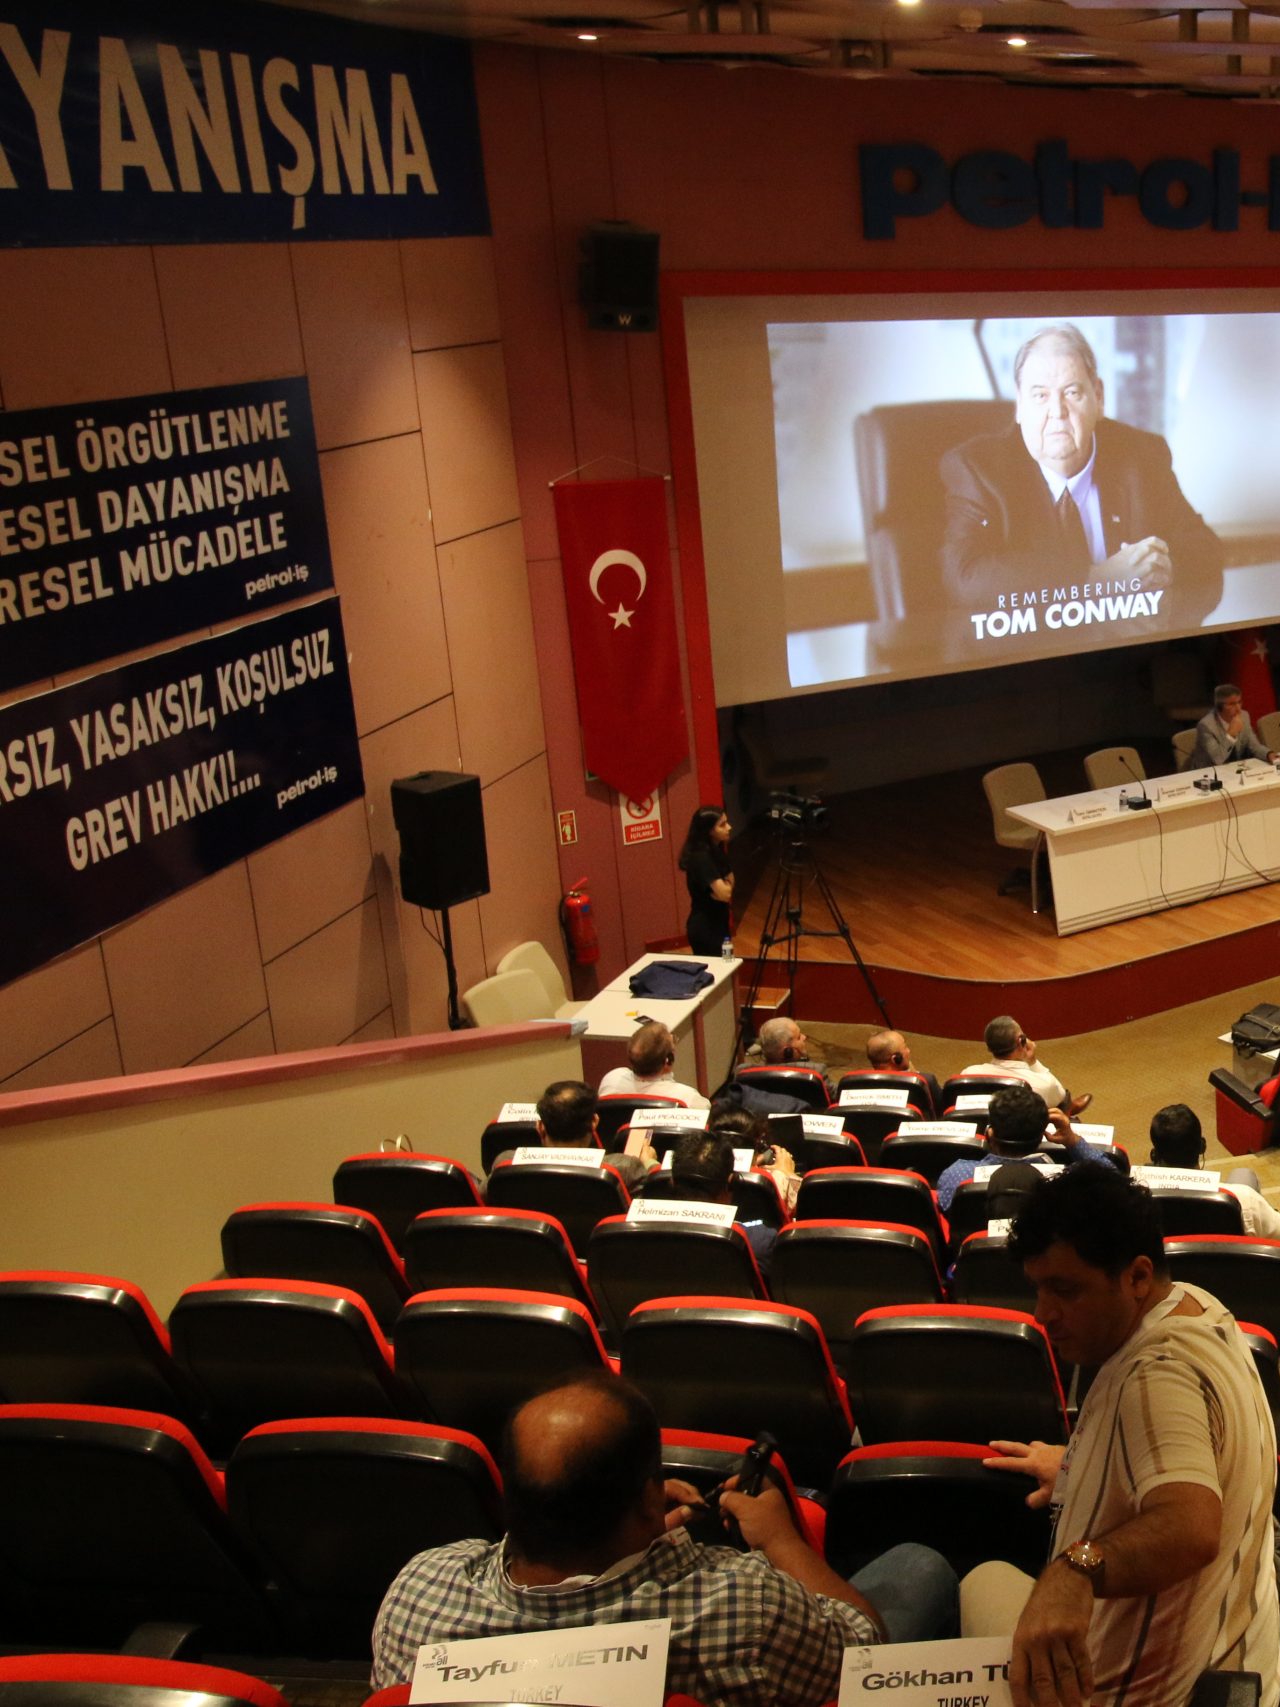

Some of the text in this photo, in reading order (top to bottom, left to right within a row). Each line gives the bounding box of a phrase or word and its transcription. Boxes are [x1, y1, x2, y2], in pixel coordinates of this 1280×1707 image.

[0, 23, 438, 229] YANIŞMA
[77, 400, 290, 473] ÖRGÜTLENME
[98, 457, 290, 533] DAYANIŞMA
[120, 512, 287, 591] MÜCADELE
[971, 590, 1163, 640] TOM CONWAY
[998, 578, 1142, 608] REMEMBERING
[70, 674, 215, 772] YASAKSIZ,
[216, 629, 334, 714] KOŞULSUZ
[66, 791, 141, 871] GREV
[1169, 1174, 1211, 1184] KARKERA
[551, 1645, 649, 1668] METIN
[862, 1669, 973, 1691] Gökhan
